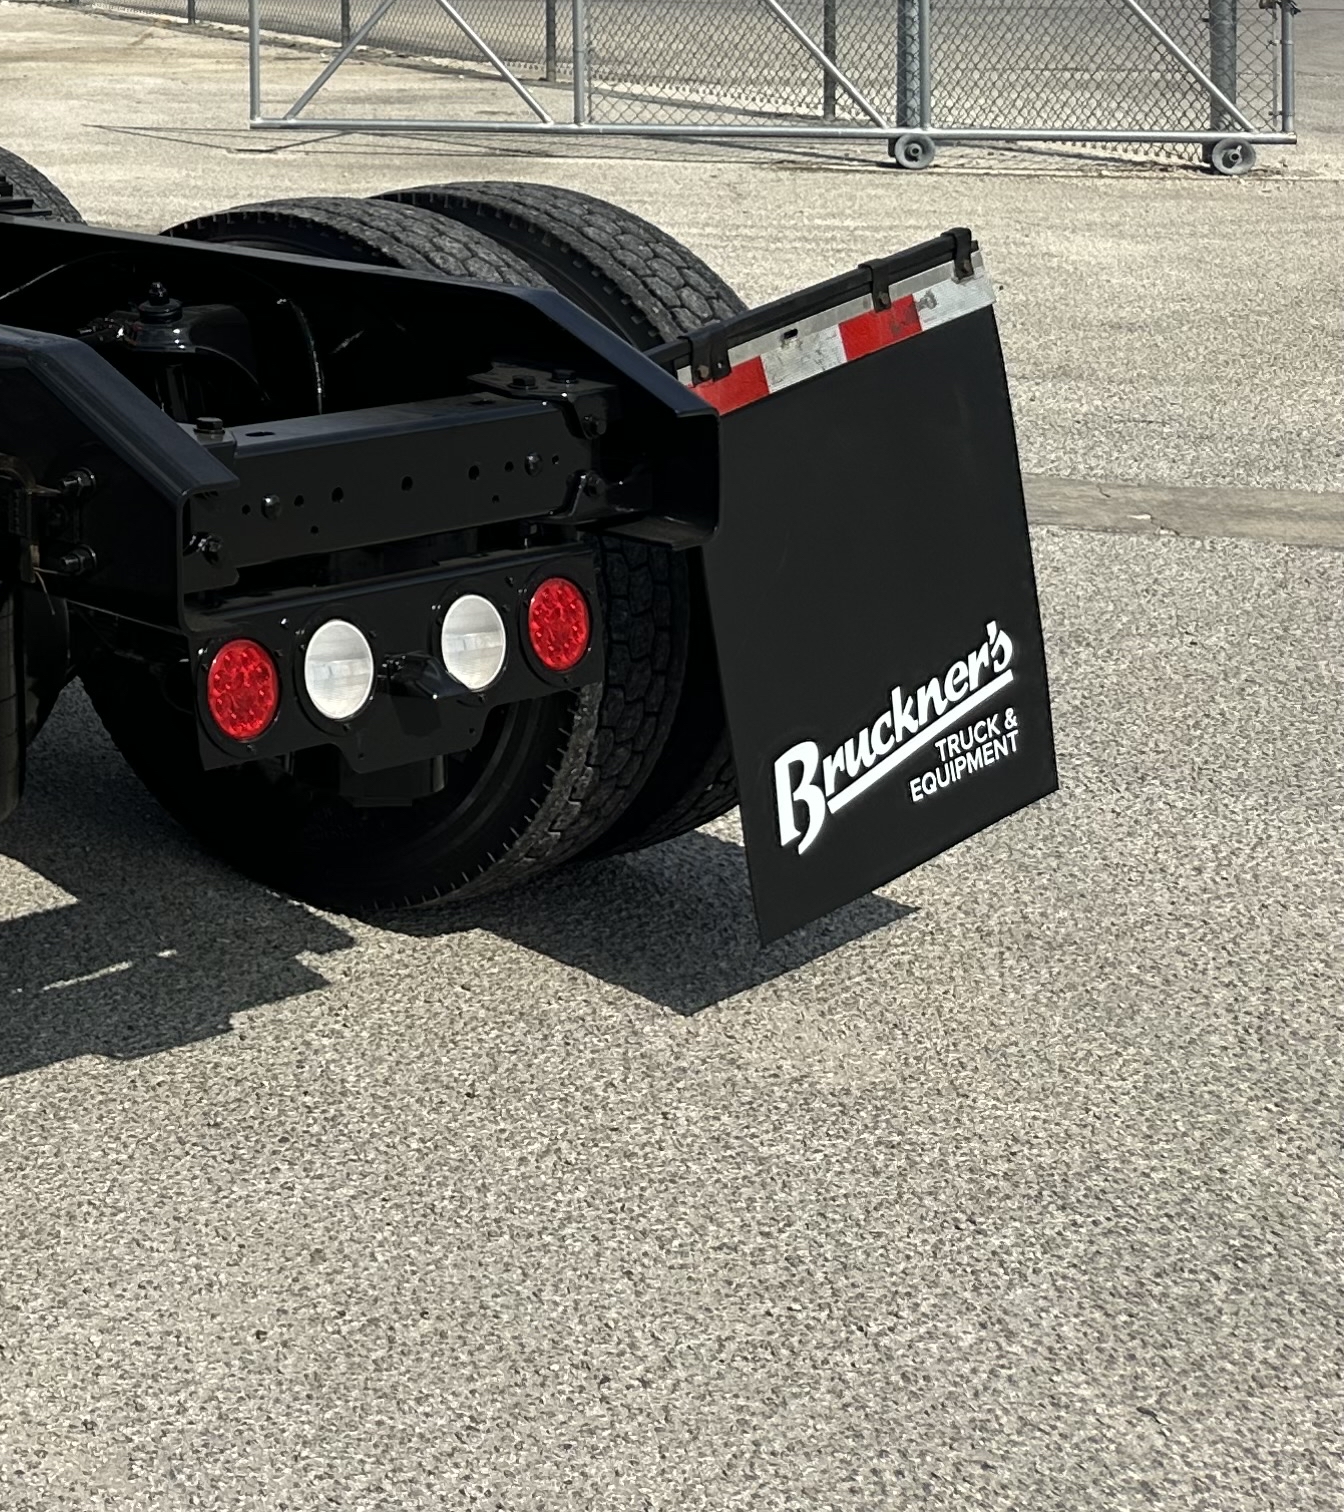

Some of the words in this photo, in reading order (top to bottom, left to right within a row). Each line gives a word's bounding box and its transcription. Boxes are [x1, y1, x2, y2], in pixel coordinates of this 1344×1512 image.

[774, 620, 1014, 856] Bruckner's
[909, 729, 1019, 803] EQUIPMENT
[934, 712, 1000, 762] TRUCK
[1004, 707, 1018, 730] &
